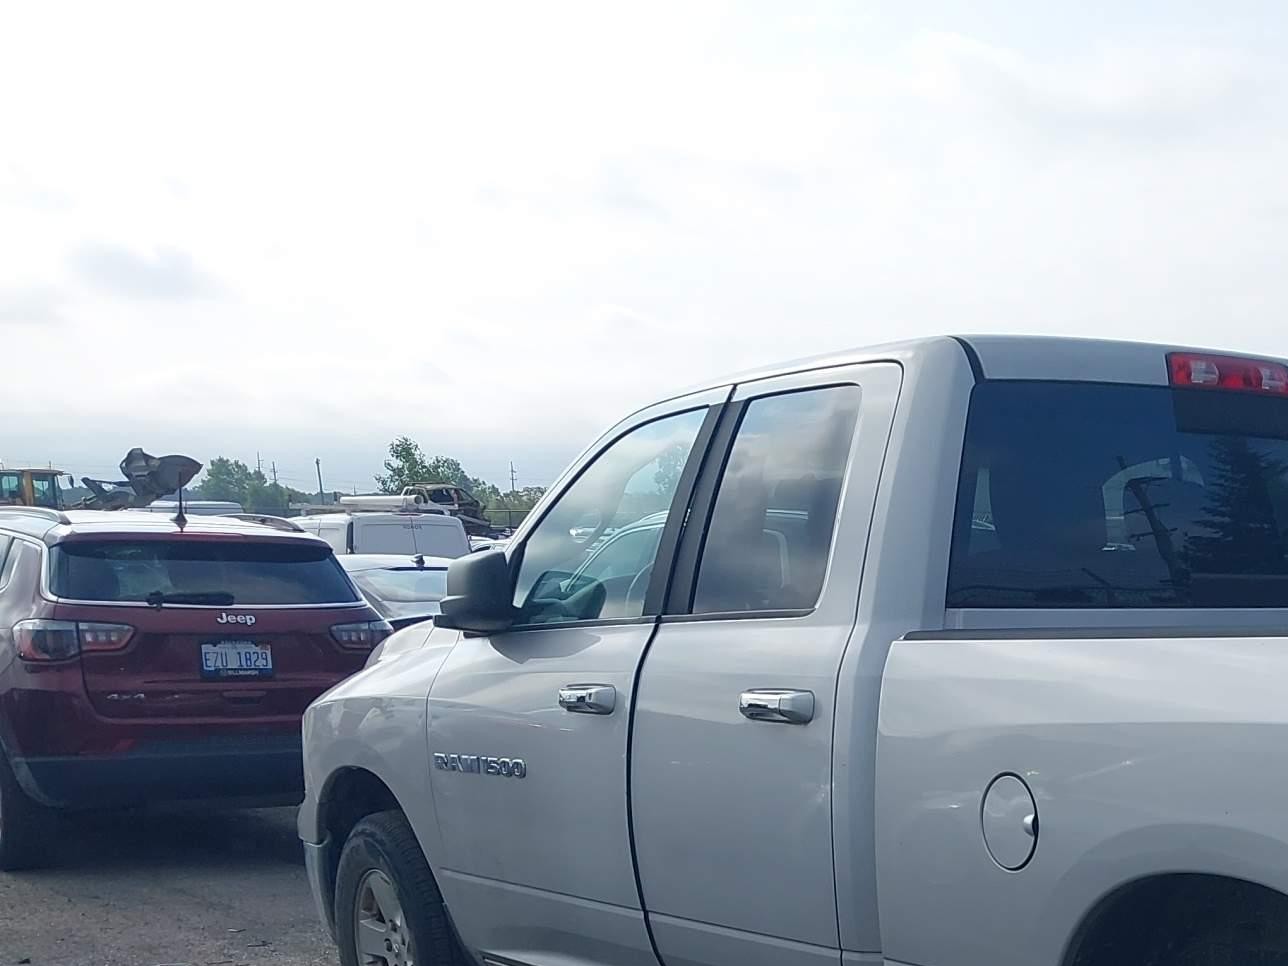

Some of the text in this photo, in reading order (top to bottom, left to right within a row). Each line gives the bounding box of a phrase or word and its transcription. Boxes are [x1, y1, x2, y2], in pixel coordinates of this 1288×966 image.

[217, 612, 256, 626] Jeep
[204, 650, 269, 668] EZU 1829
